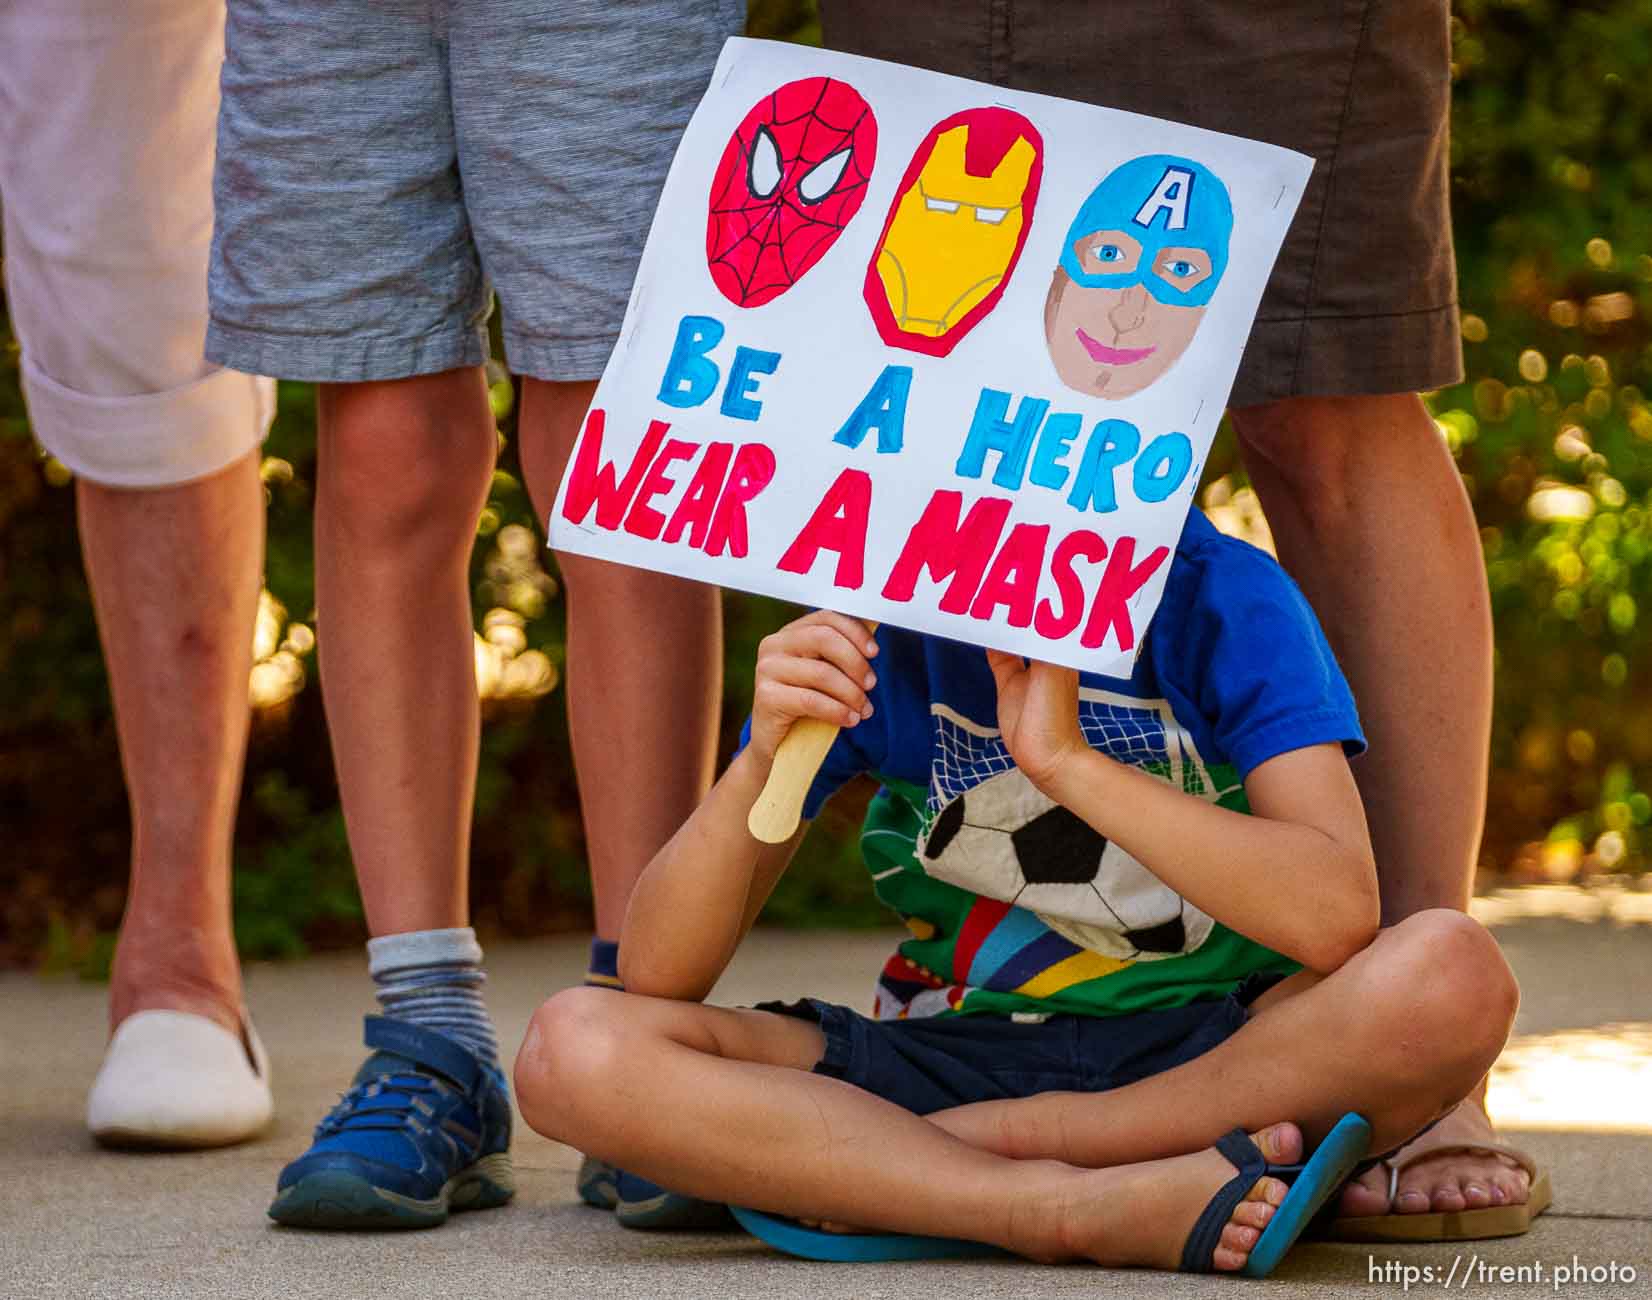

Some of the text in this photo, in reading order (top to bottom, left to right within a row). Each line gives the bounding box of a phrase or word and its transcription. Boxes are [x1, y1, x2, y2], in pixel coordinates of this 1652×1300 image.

[1132, 165, 1196, 230] A
[656, 315, 1193, 514] BE A HERO
[562, 408, 1169, 652] WEAR A MASK
